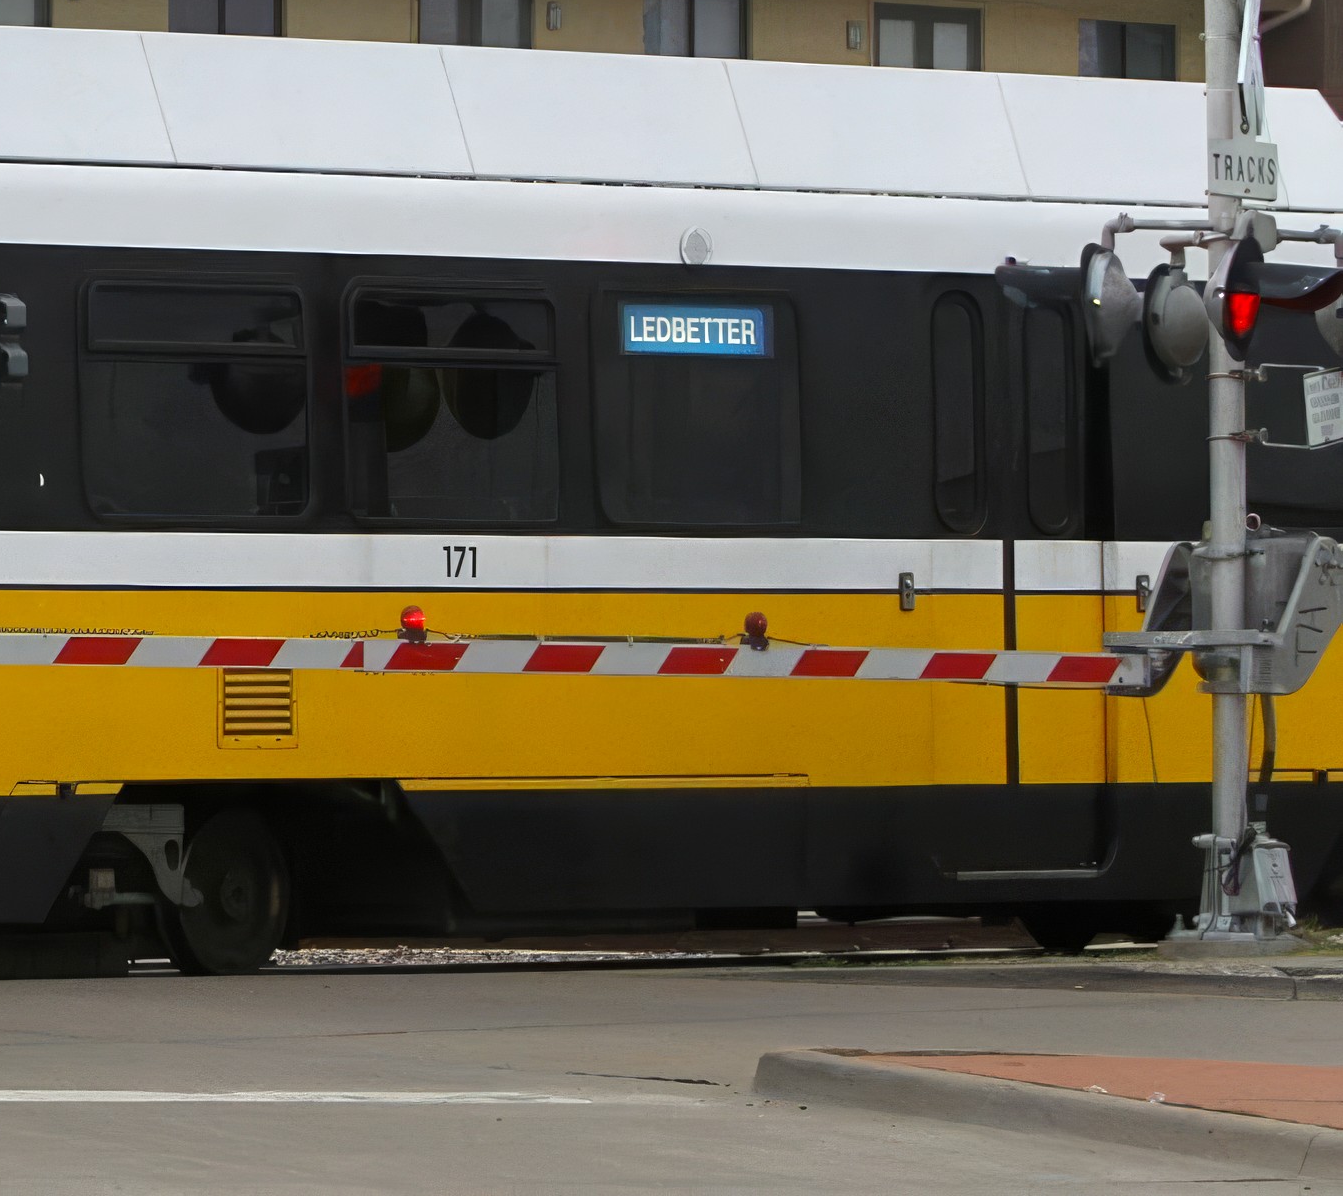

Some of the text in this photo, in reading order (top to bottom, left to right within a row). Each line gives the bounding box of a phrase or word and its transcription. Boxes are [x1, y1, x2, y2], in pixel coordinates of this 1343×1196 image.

[1213, 153, 1277, 186] TRACKS
[630, 315, 757, 345] LEDBETTER
[442, 545, 477, 578] 171
